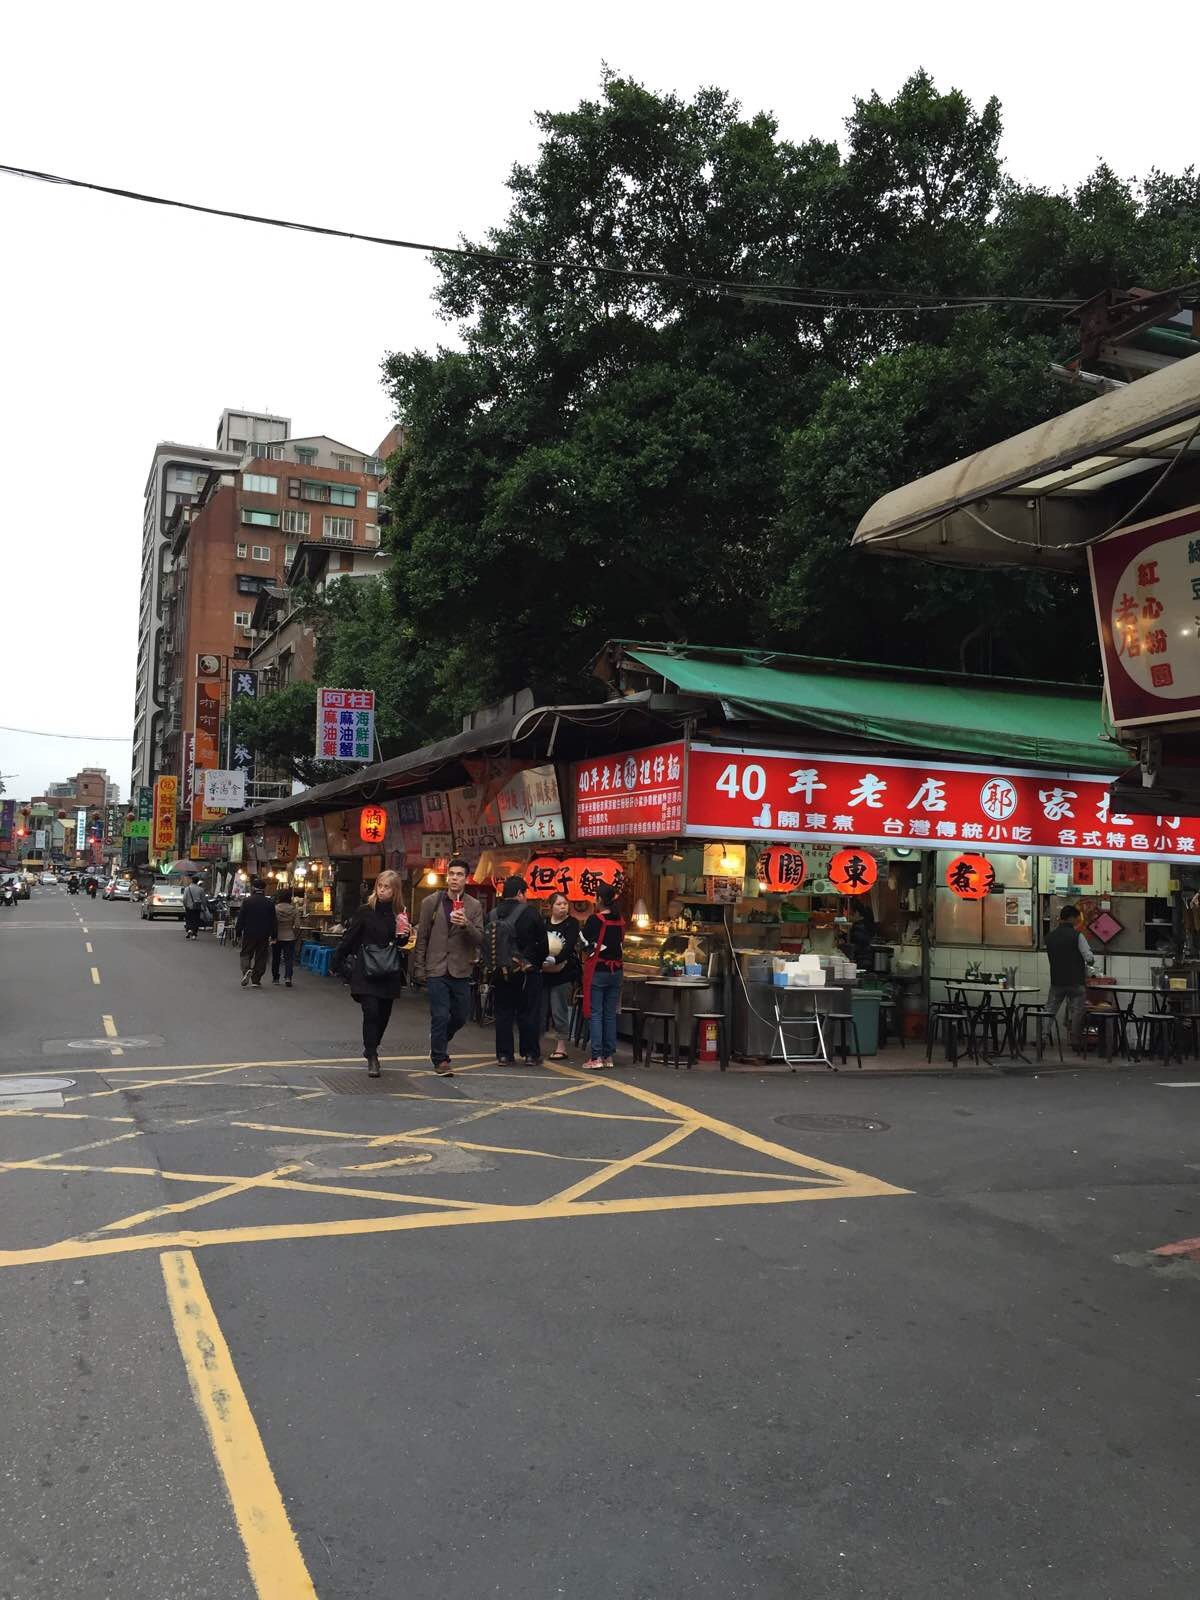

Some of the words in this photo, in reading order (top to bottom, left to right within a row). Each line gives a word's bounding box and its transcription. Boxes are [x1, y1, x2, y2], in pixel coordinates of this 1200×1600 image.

[1116, 593, 1141, 657] 老店
[777, 810, 855, 832] 關東煮
[882, 817, 1033, 842] 台灣傳統小吃
[1057, 829, 1196, 852] 各式特色小菜
[843, 855, 871, 888] 東
[949, 861, 978, 893] 煮
